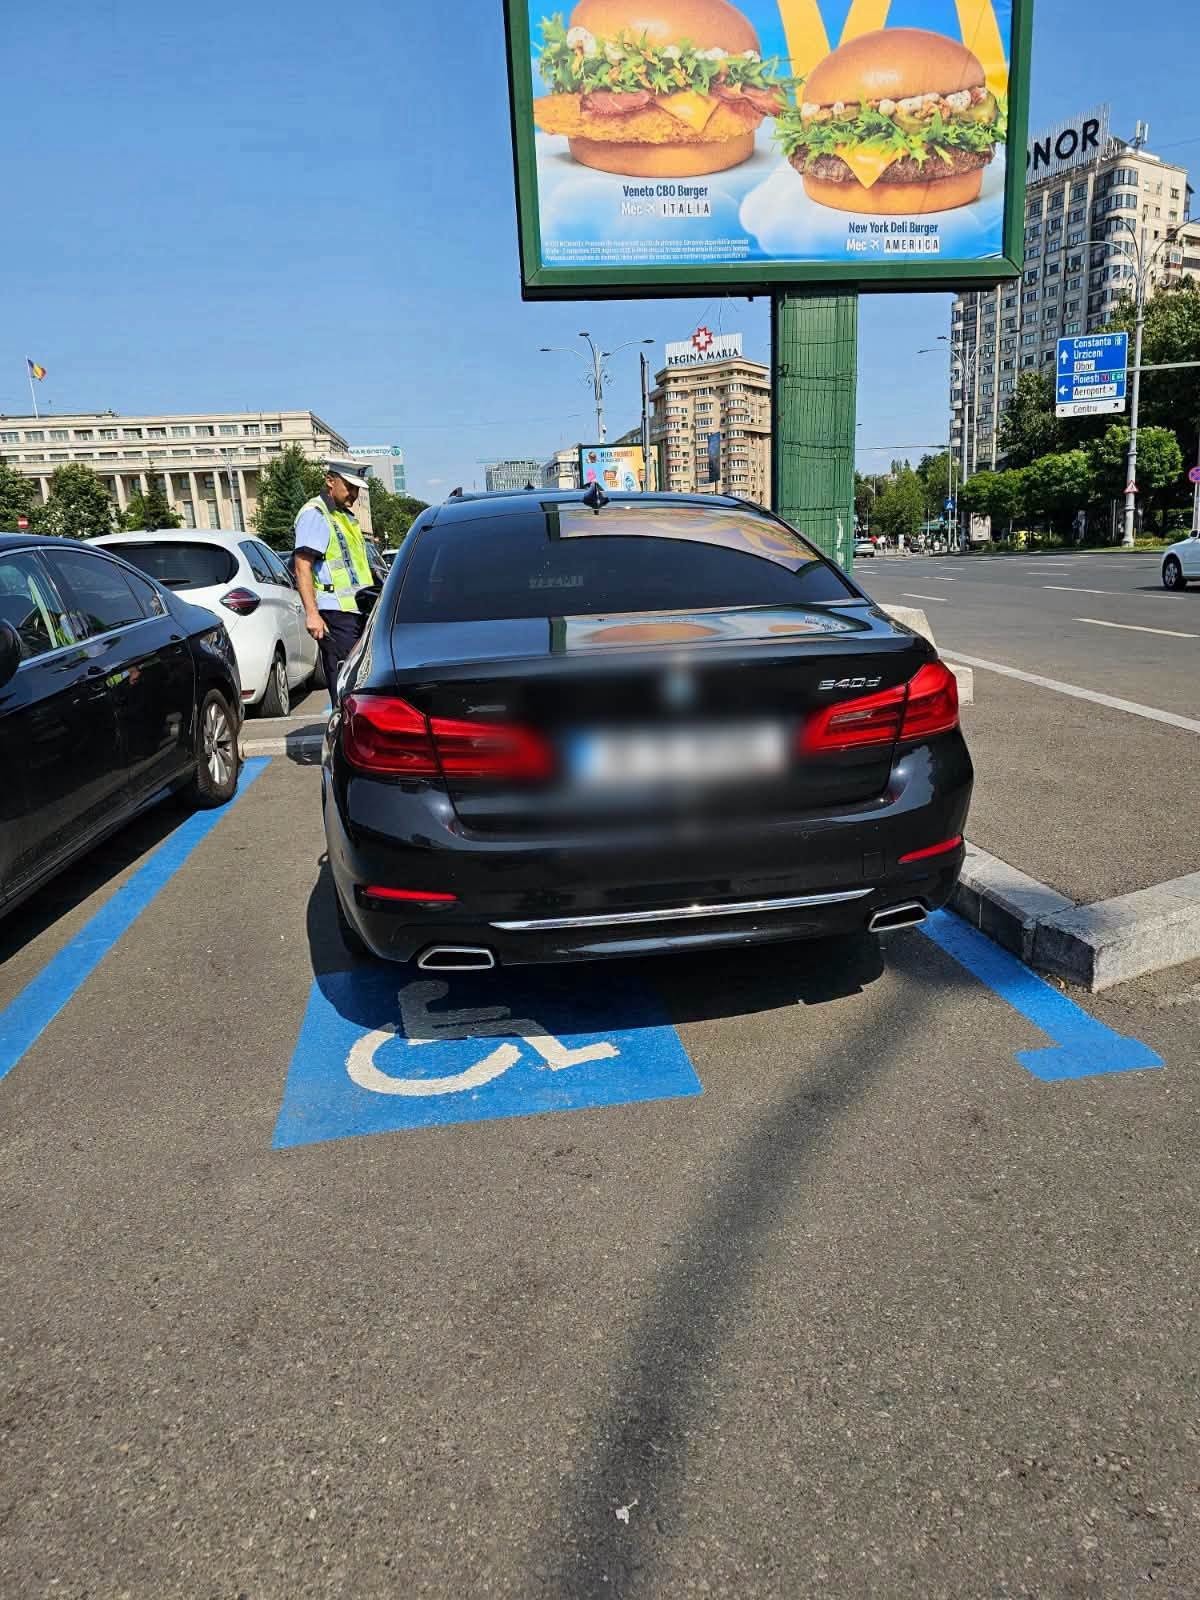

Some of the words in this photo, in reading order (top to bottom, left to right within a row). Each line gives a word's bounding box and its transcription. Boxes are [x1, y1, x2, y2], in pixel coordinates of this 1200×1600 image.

[1026, 118, 1100, 171] NOR
[623, 185, 654, 197] Veneto
[656, 185, 676, 197] CBO
[678, 185, 708, 199] Burger
[621, 201, 643, 216] Mec
[663, 203, 710, 214] ITALIA
[848, 222, 867, 233] New
[869, 221, 889, 233] York
[890, 221, 907, 233] Deli
[909, 221, 938, 235] Burger
[846, 238, 866, 251] Mec
[885, 239, 938, 250] AMERICA
[668, 352, 703, 365] REGINA
[706, 347, 738, 360] MARIA
[1074, 386, 1106, 397] Aeroport
[1073, 405, 1098, 414] Centru
[818, 676, 882, 690] 540d
